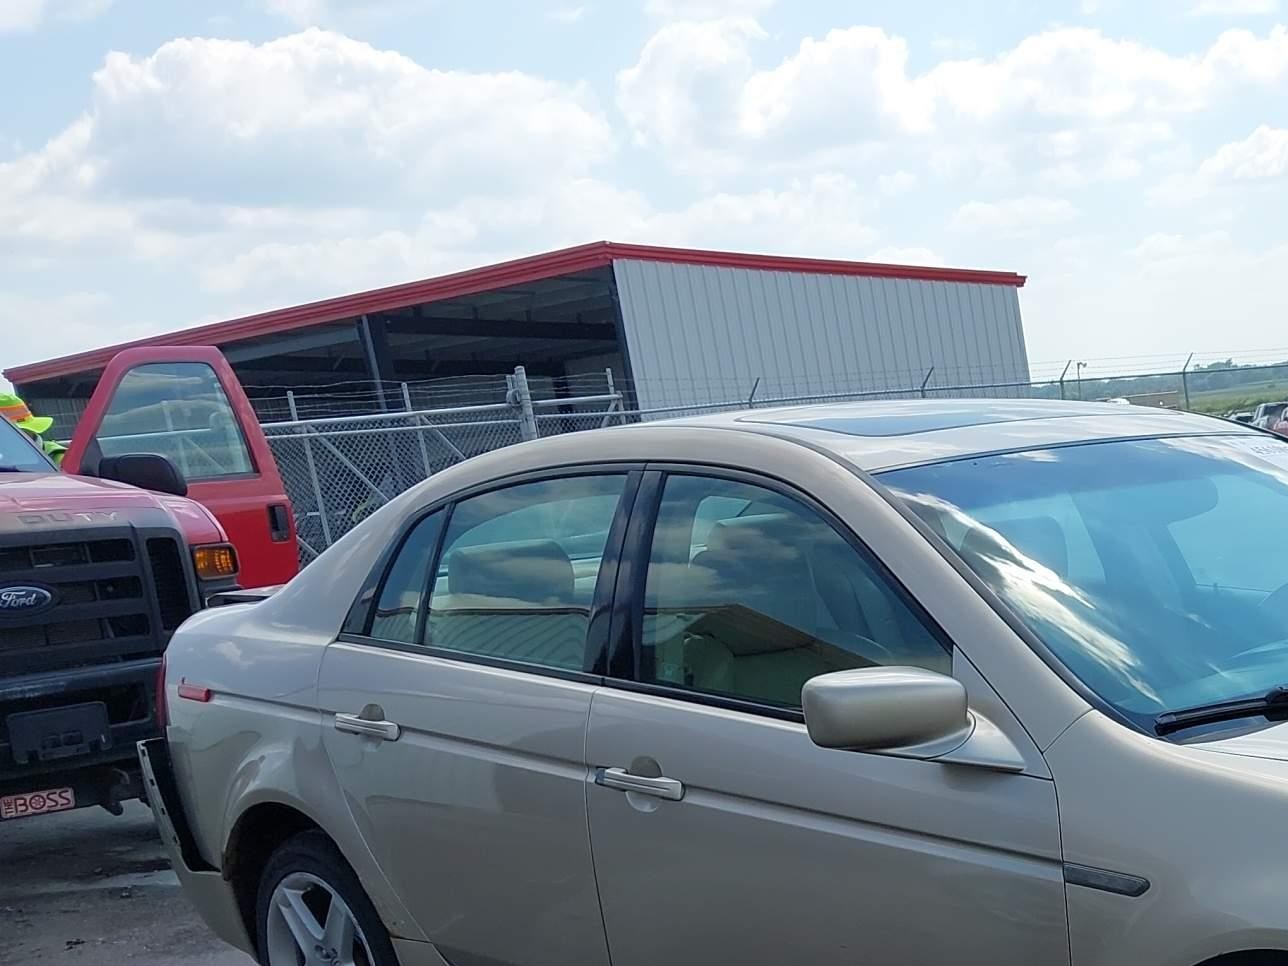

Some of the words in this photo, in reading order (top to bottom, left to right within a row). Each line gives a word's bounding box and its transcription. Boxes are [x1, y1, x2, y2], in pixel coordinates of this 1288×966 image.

[16, 510, 120, 525] DUTY
[0, 591, 37, 608] Ford
[15, 789, 71, 814] BOSS
